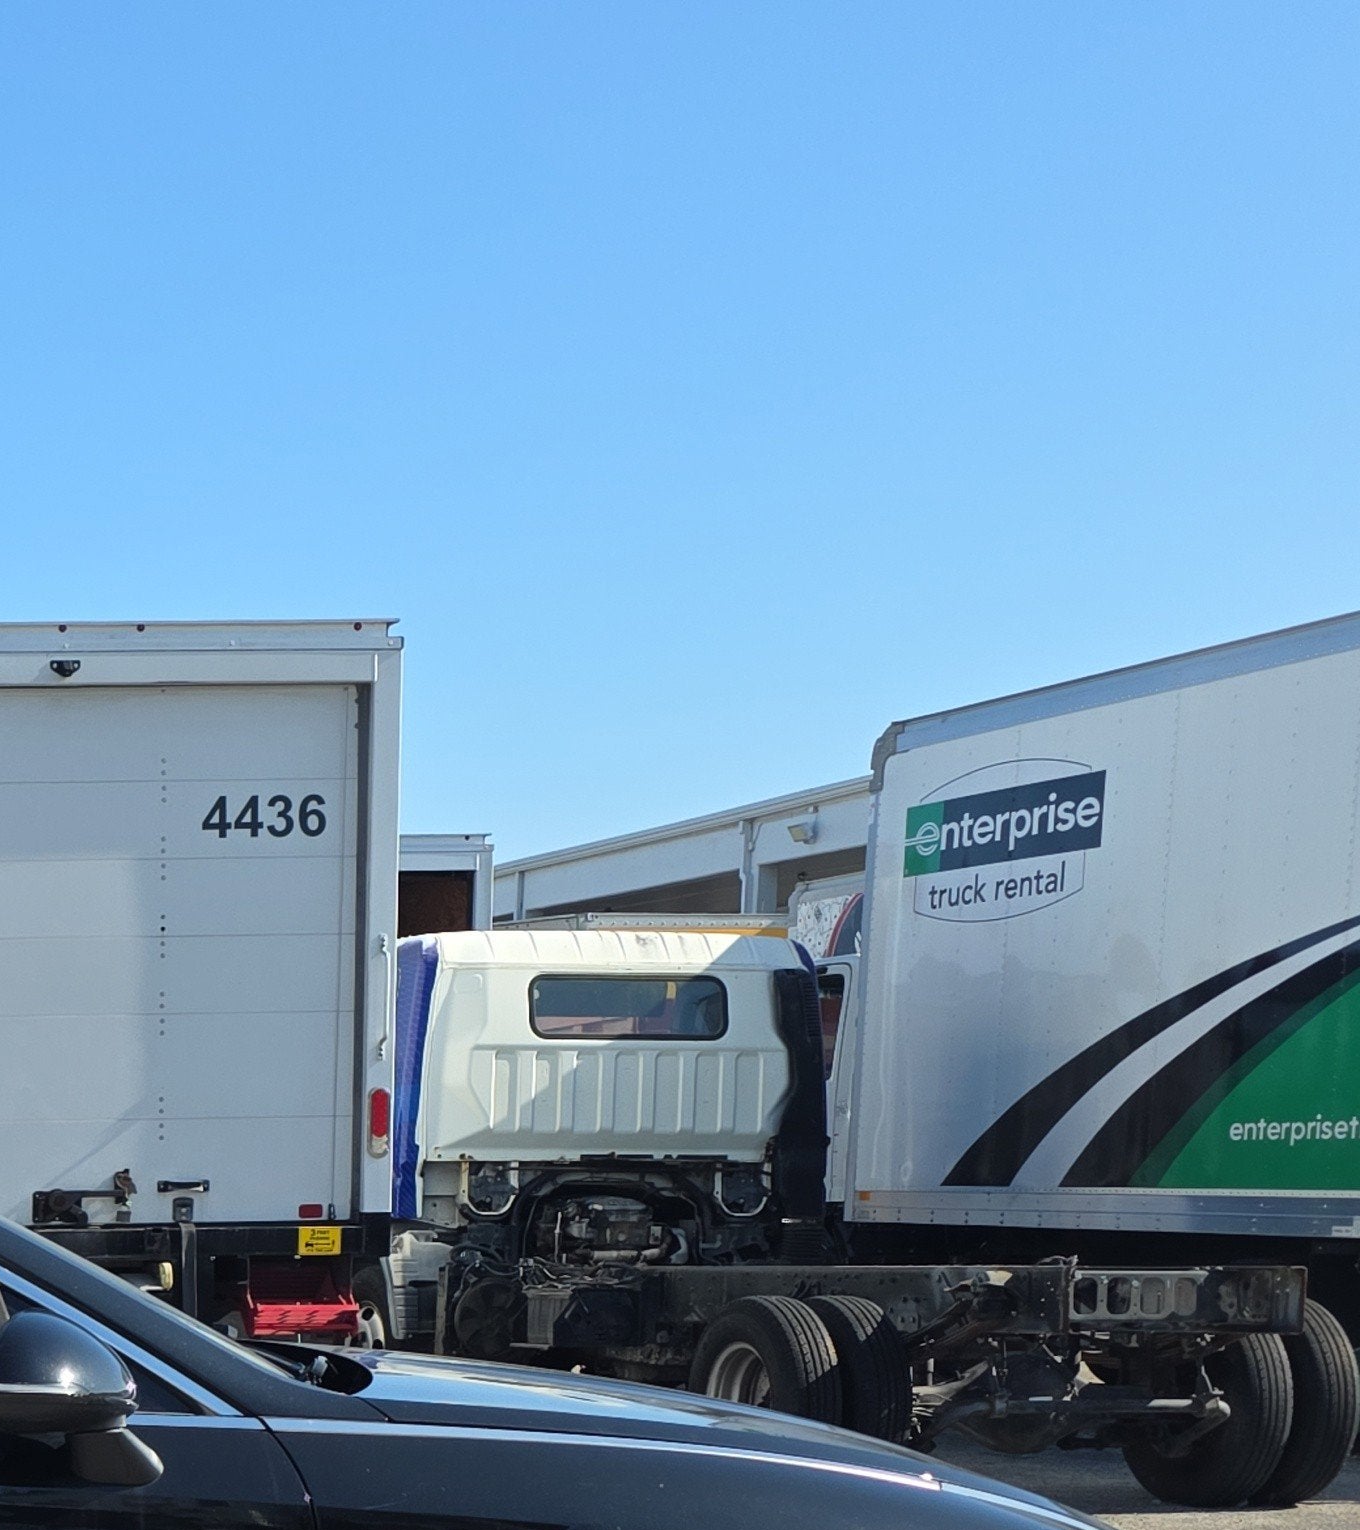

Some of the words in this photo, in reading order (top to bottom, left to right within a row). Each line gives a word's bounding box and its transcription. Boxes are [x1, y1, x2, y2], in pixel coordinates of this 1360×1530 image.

[201, 794, 327, 839] 4436
[905, 792, 1101, 856] enterprise
[928, 873, 986, 910] truck
[994, 860, 1067, 901] rental
[1229, 1113, 1360, 1147] enterpriset
